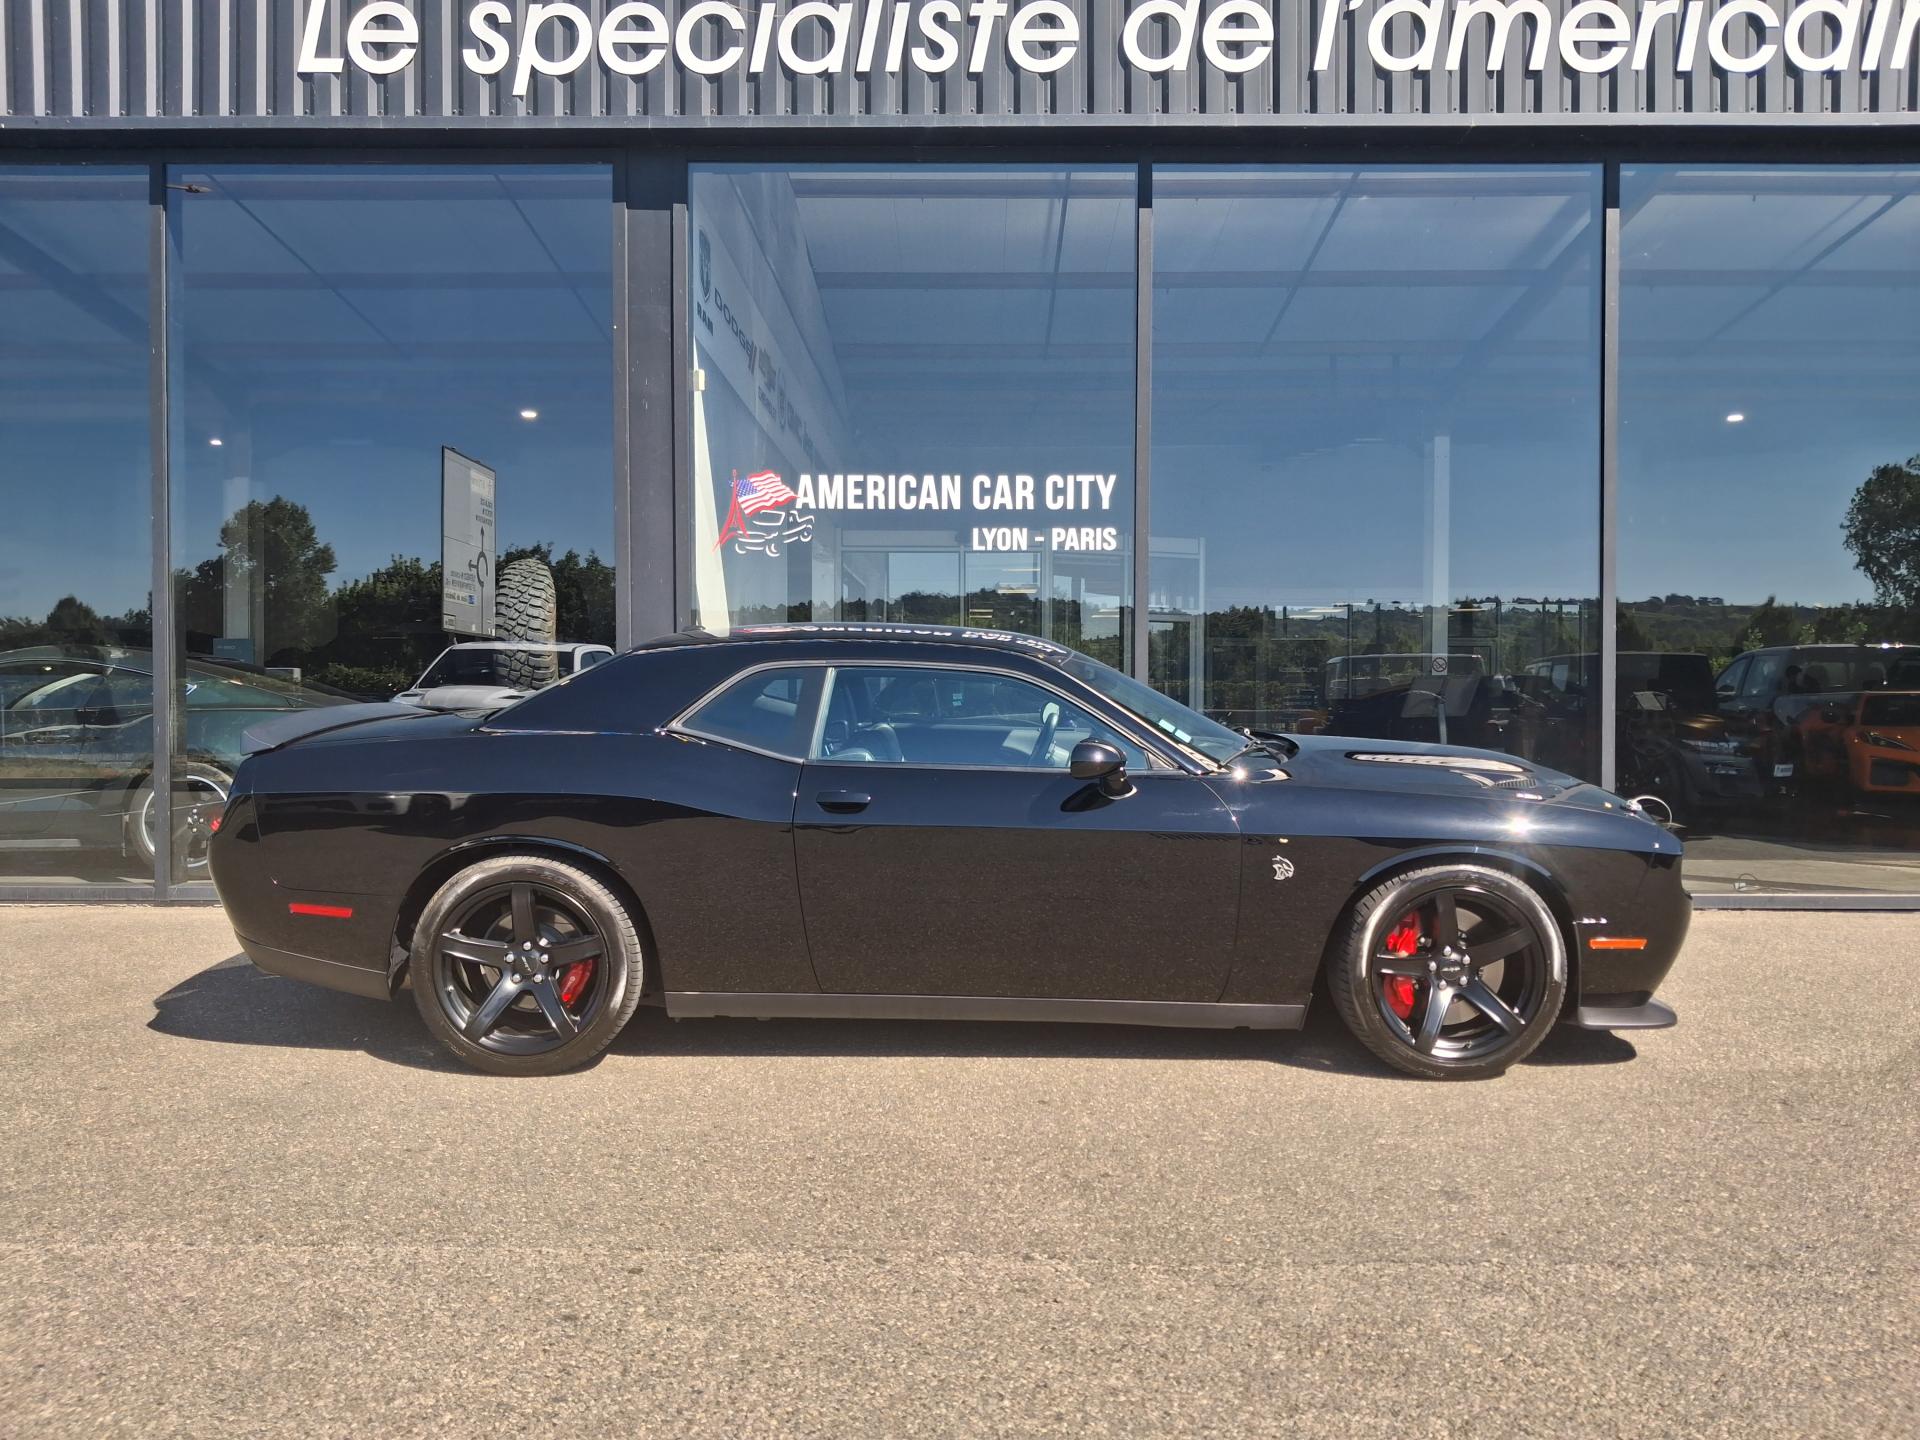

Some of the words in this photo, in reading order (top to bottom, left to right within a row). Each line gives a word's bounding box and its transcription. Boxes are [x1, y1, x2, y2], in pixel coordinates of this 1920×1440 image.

[297, 0, 419, 74] Le
[1122, 0, 1275, 73] de
[697, 302, 714, 336] RAM
[796, 474, 962, 510] AMERICAN
[972, 474, 1036, 510] CAR
[1044, 474, 1118, 510] CITY
[971, 527, 1028, 551] LYON
[1034, 534, 1046, 543] -
[1051, 527, 1118, 551] PARIS
